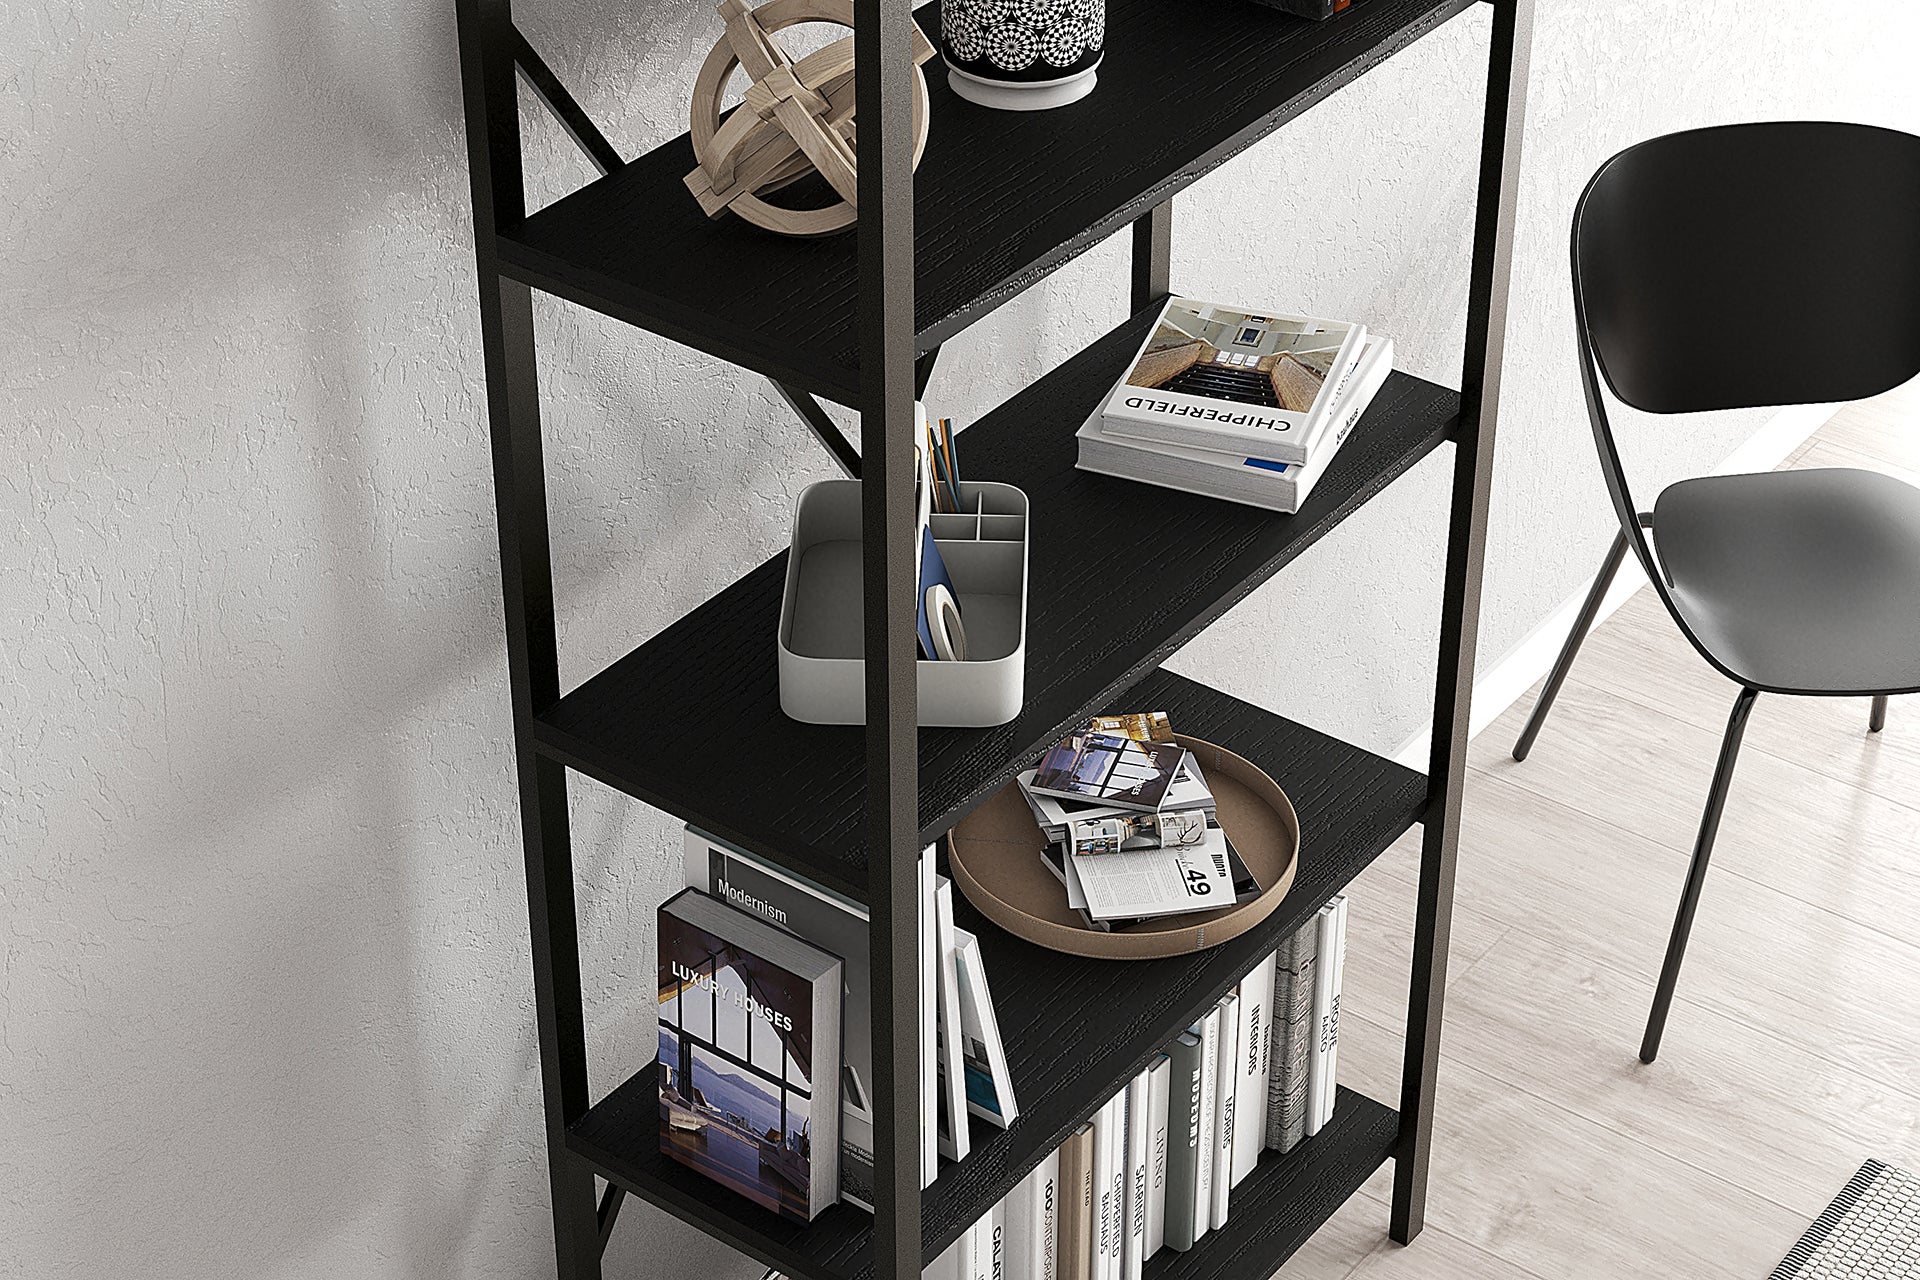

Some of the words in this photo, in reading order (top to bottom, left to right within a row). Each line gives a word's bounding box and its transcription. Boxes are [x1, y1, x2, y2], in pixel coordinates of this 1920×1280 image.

[1125, 396, 1291, 432] CHIPPERFIELD
[718, 878, 788, 925] Modernism
[1186, 869, 1212, 896] 49
[672, 960, 729, 1001] LUXURY
[734, 991, 793, 1032] HOUSES
[1248, 1003, 1260, 1076] INTERIORS
[1261, 1023, 1271, 1076] bauhaus
[1291, 960, 1310, 1102] CONCRETE
[1320, 1015, 1329, 1053] AALTO
[1189, 1066, 1200, 1148] MUSEUMS
[1222, 1095, 1233, 1150] MORRIS
[1154, 1126, 1165, 1189] LIVING
[1100, 1191, 1110, 1255] BAUHAUS
[1112, 1172, 1122, 1258] CHIPPERFIELD
[1133, 1164, 1144, 1238] SAARINEN
